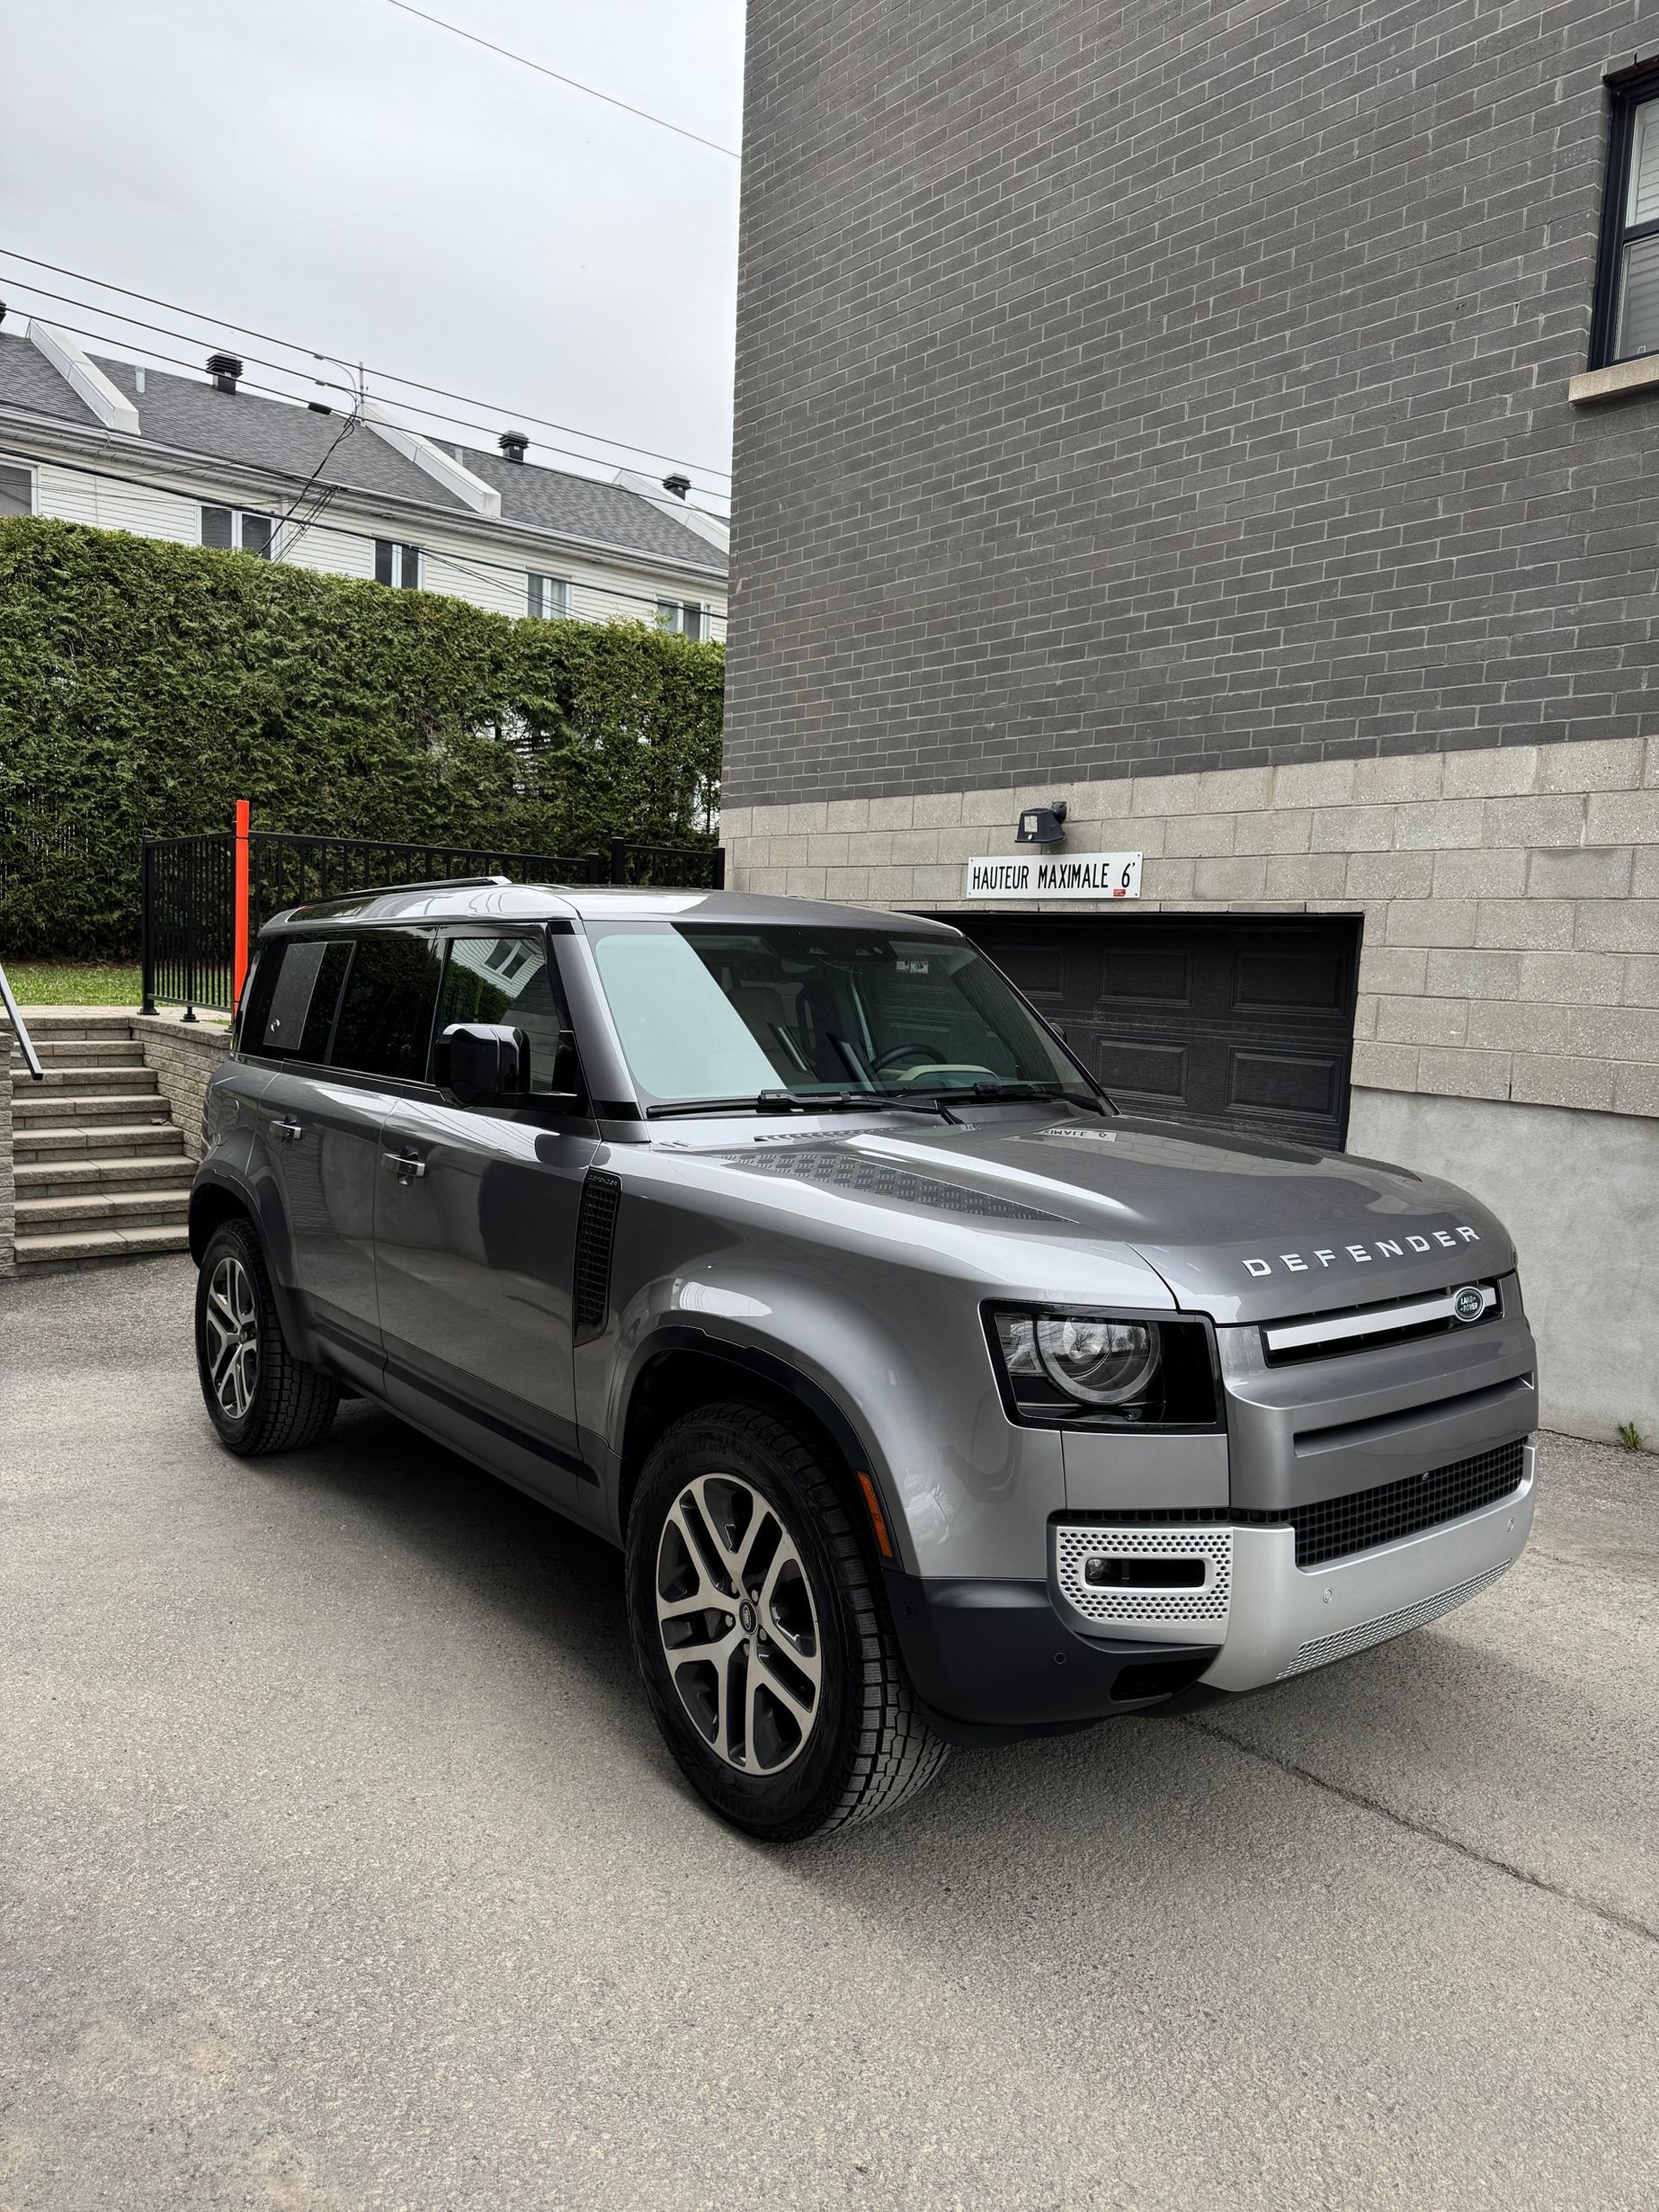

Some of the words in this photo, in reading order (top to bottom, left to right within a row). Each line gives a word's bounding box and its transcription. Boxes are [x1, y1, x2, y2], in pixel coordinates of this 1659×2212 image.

[972, 865, 1030, 889] HAUTEUR
[1038, 862, 1110, 889] MAXIMALE
[1121, 861, 1136, 888] 6'
[1241, 1225, 1481, 1278] DEFENDER
